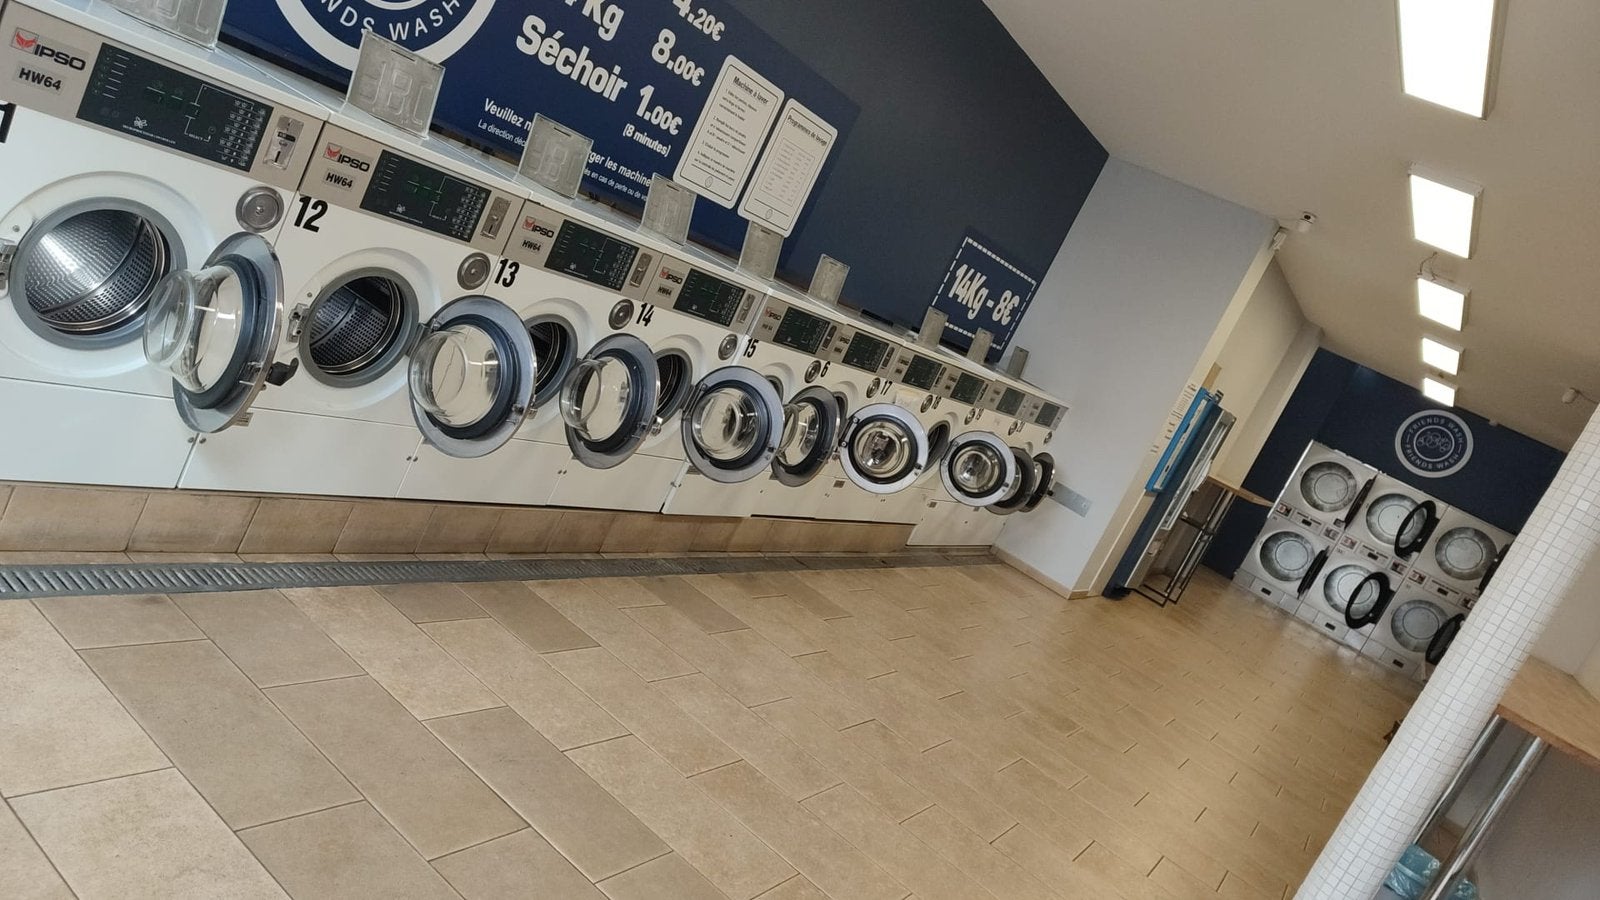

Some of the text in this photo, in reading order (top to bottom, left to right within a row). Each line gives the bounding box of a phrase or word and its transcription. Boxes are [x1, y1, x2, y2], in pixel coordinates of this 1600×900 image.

[389, 0, 460, 41] WASH
[564, 0, 625, 41] Kg
[672, 0, 725, 42] 4.20€
[34, 44, 87, 71] IPSO
[515, 14, 629, 102] Séchoir
[651, 28, 705, 87] 8.00€
[19, 67, 62, 91] HW64
[636, 84, 683, 136] 1.00€
[485, 97, 524, 127] Veuillez
[604, 156, 618, 171] les
[622, 123, 672, 157] (8 minutes)
[337, 153, 371, 172] IPSO
[478, 118, 488, 130] La
[487, 124, 514, 142] direction
[607, 179, 615, 187] de
[325, 172, 353, 188] HW64
[293, 195, 329, 233] 12
[521, 239, 542, 252] HW64
[531, 224, 555, 238] IPSO
[494, 258, 520, 288] 13
[948, 263, 1020, 326] 14Kg - 8€
[636, 302, 655, 327] 14
[743, 338, 760, 358] 15
[820, 360, 831, 378] 6
[880, 379, 893, 396] 17
